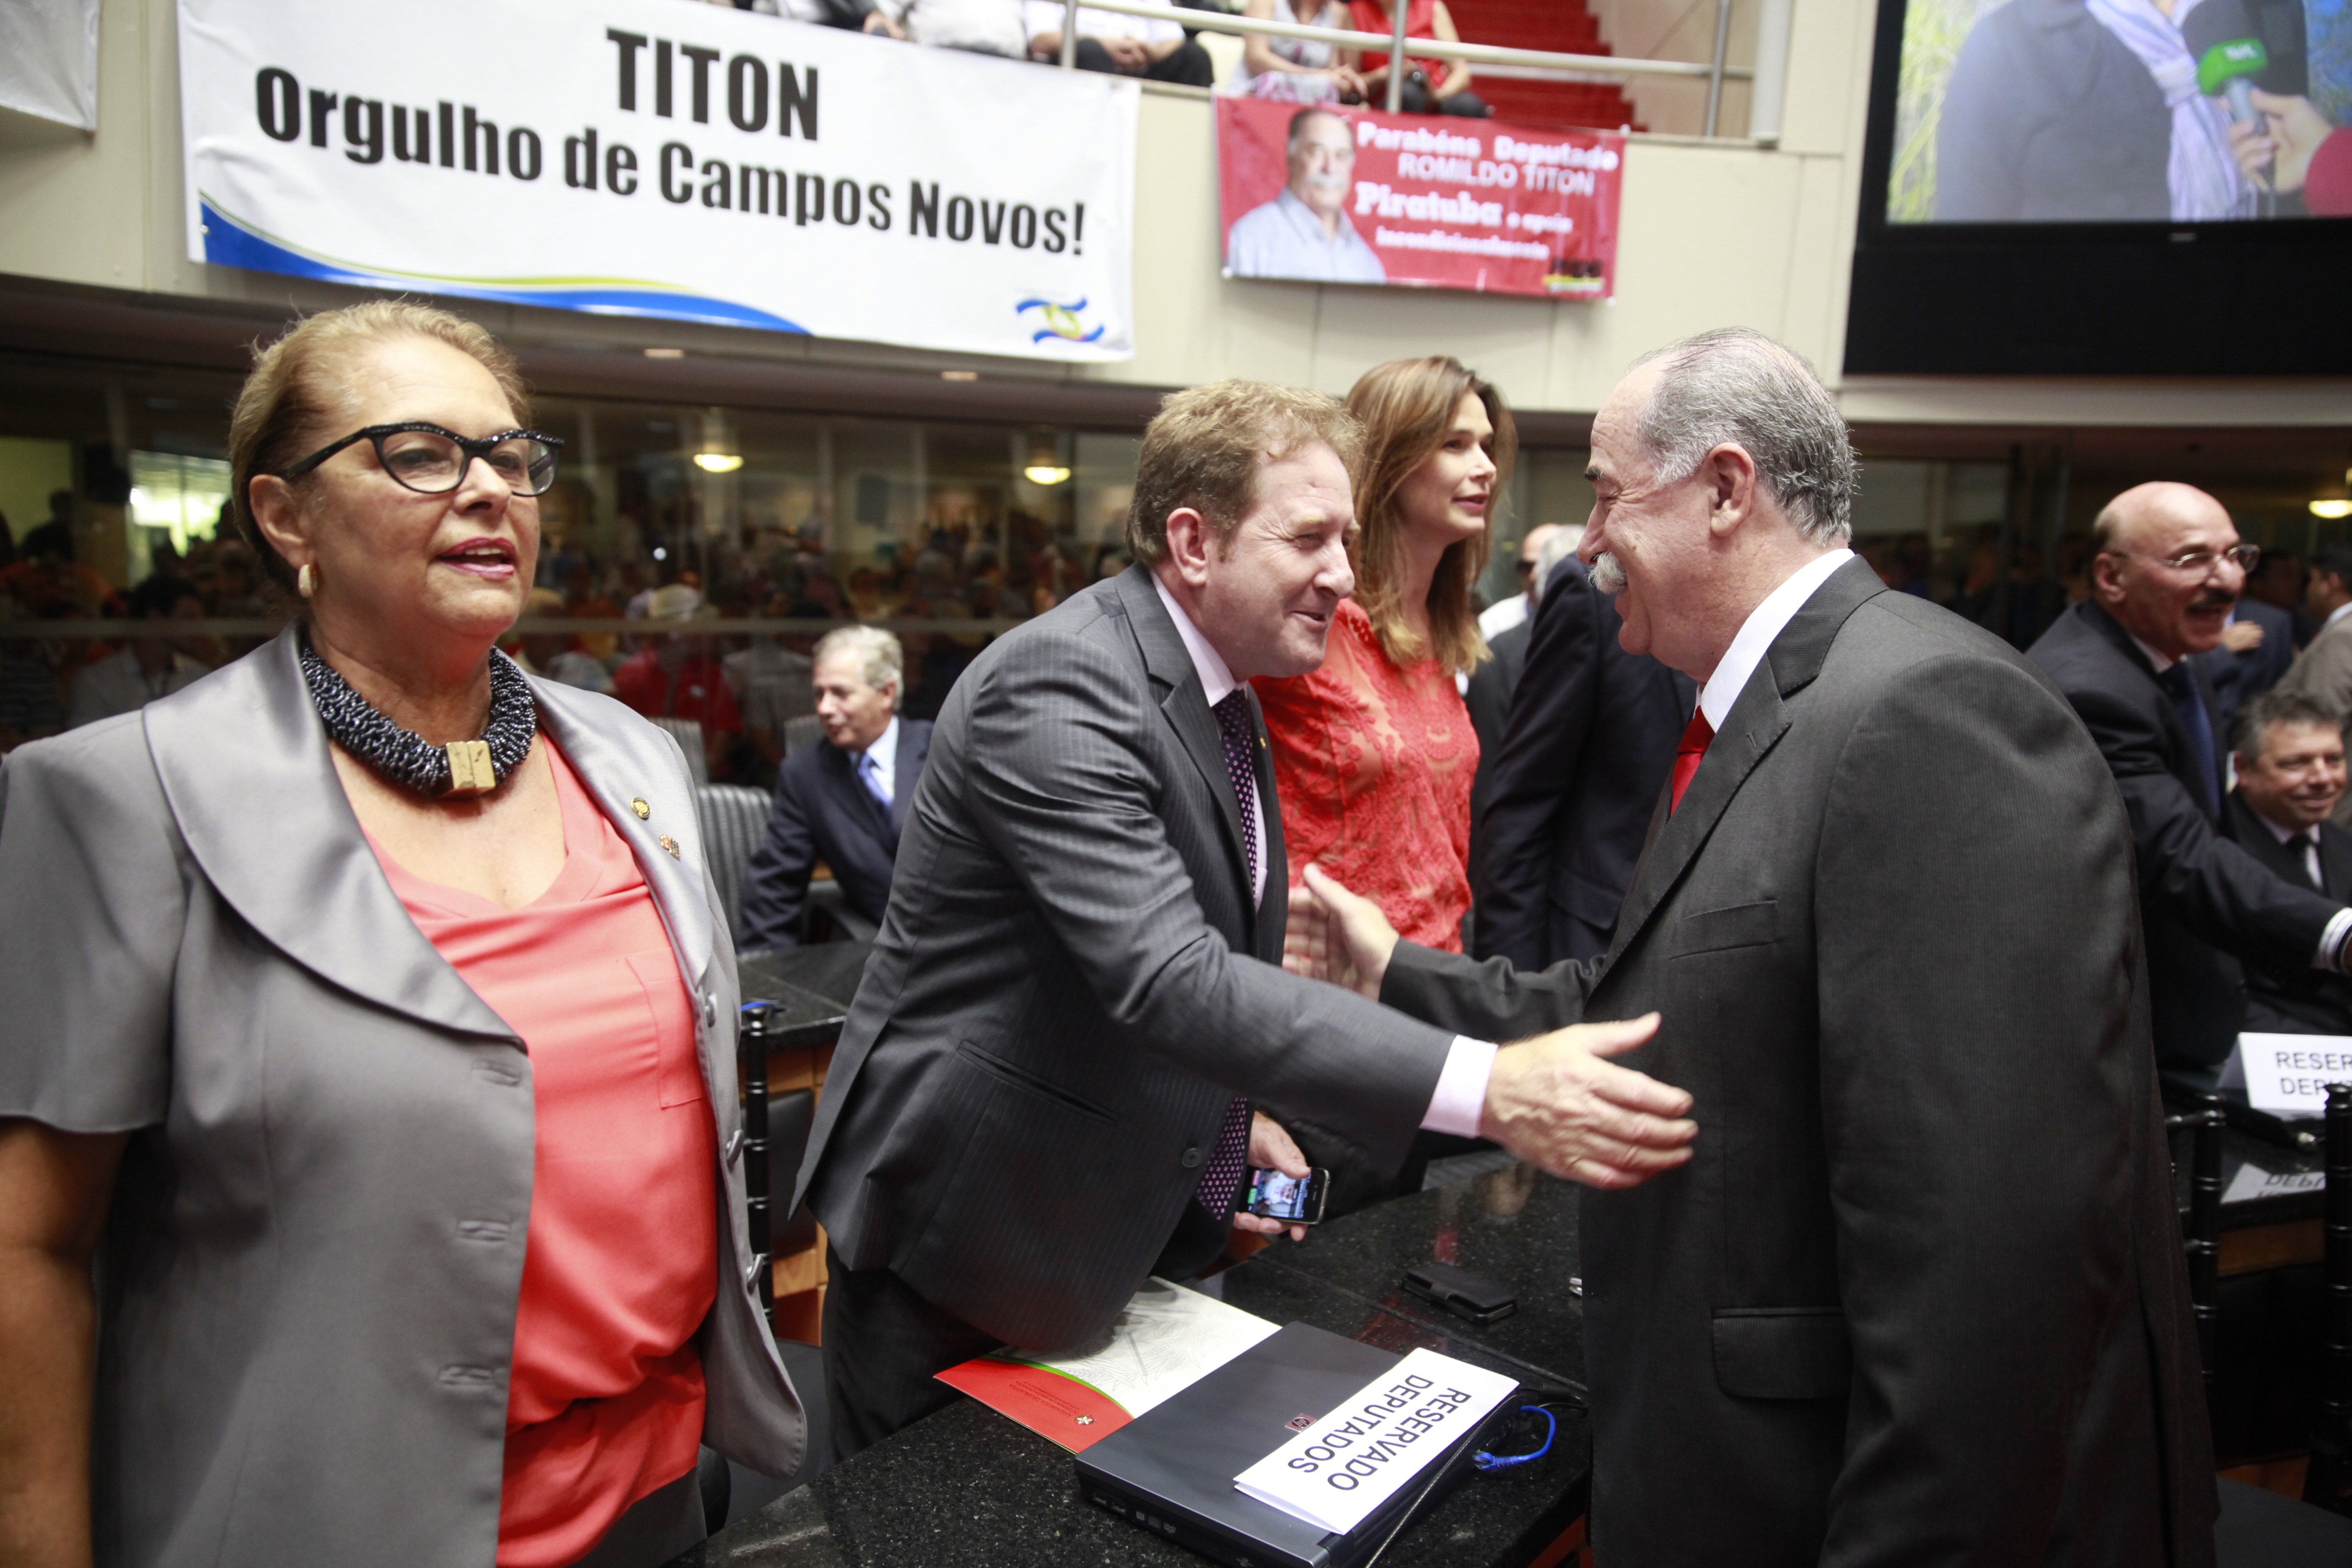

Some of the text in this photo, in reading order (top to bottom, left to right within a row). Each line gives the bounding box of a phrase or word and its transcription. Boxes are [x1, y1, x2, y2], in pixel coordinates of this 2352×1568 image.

[607, 29, 818, 141] TITON
[256, 67, 1084, 253] Orgulho de Campos Novos!
[1357, 121, 1619, 171] Parabéns Deputado
[1398, 152, 1595, 196] ROMILDO TITON
[1355, 181, 1503, 227] Piratuba
[2276, 1052, 2352, 1070] RESER
[1287, 1374, 1435, 1473] DEPUTADOS
[1291, 1418, 1309, 1428] hp
[1327, 1387, 1473, 1491] RESERVADO
[1164, 1523, 1176, 1531] DVD
